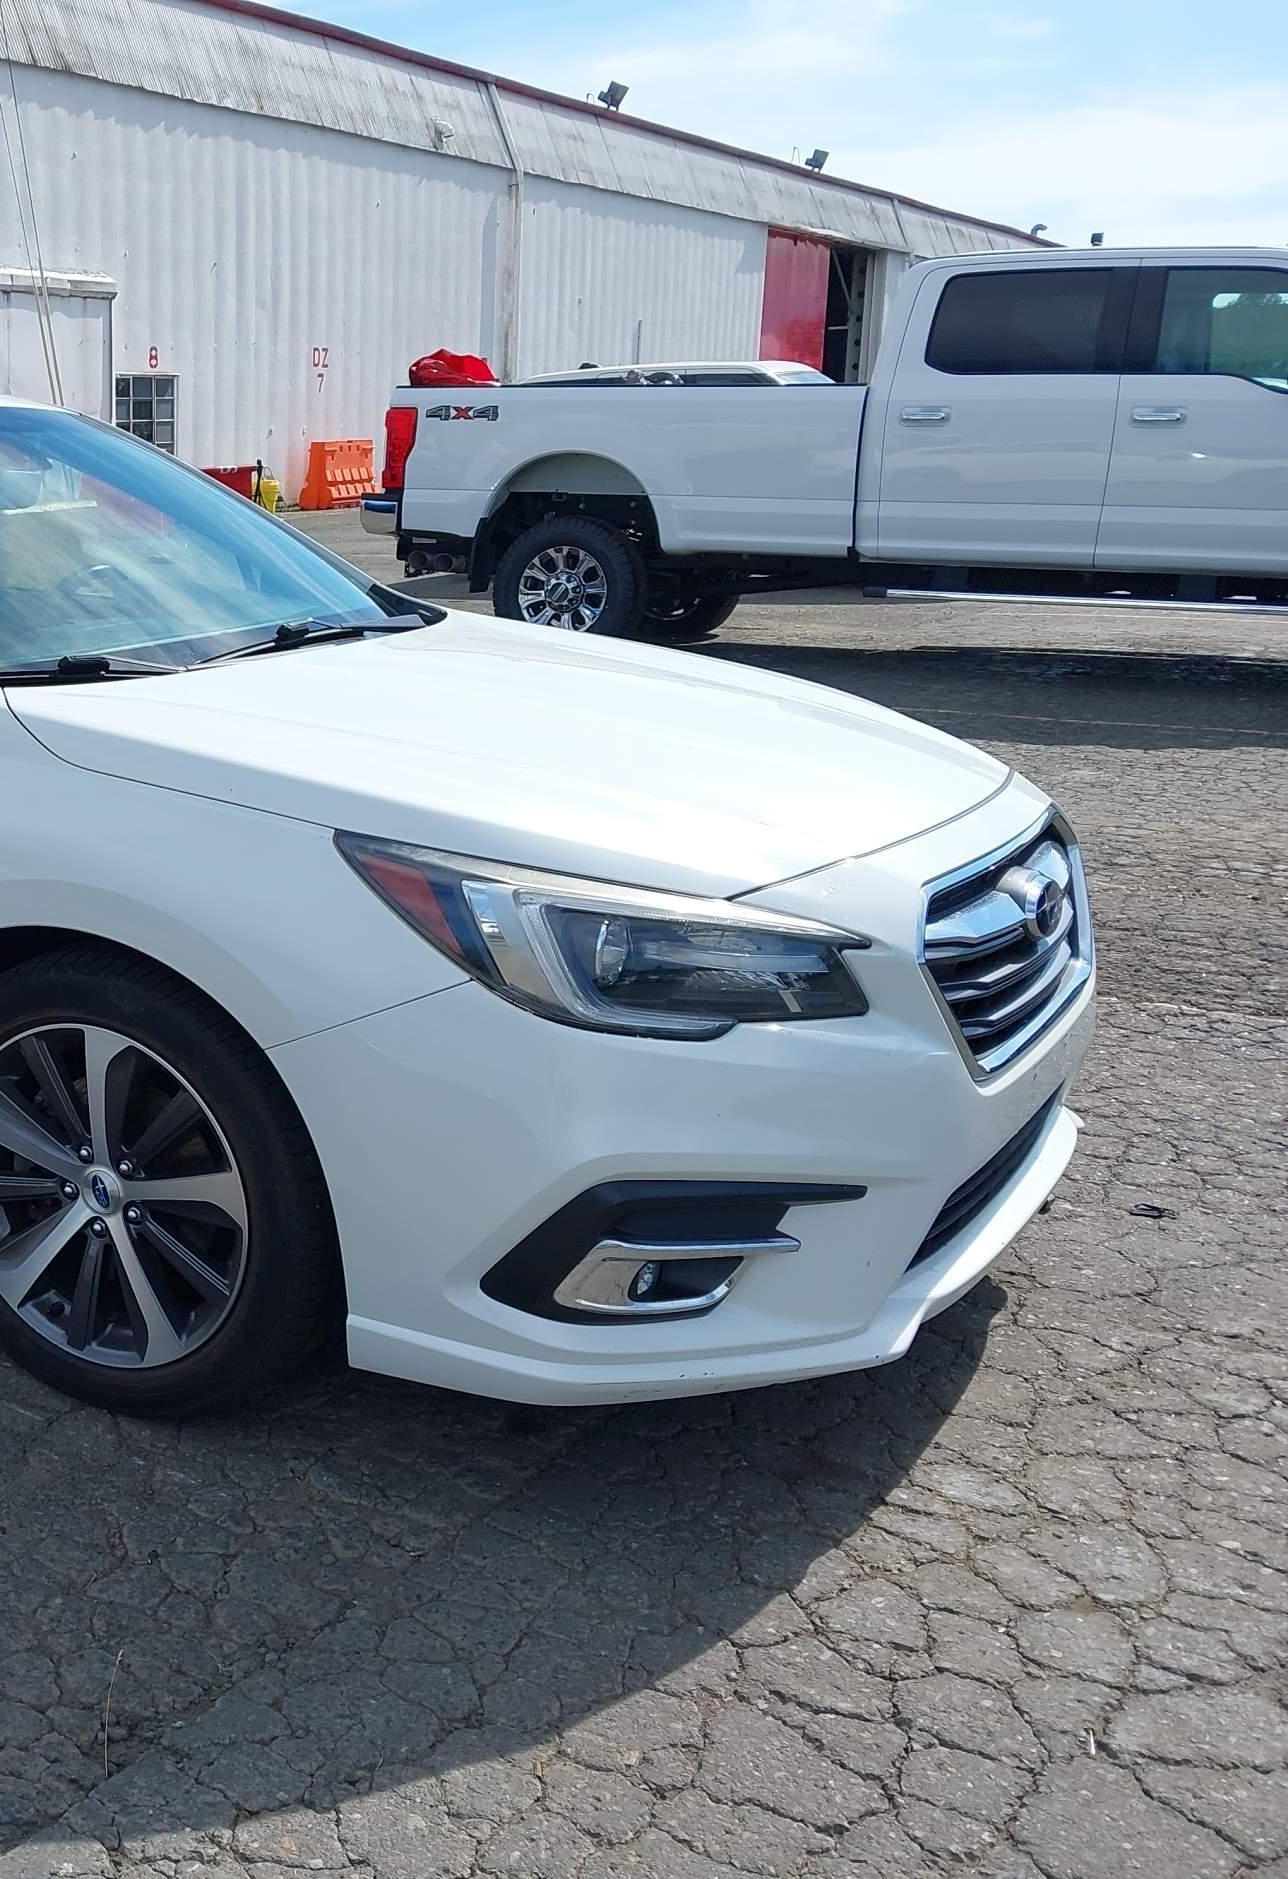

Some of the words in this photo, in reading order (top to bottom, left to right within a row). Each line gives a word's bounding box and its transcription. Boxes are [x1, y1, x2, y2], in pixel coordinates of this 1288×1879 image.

[148, 346, 159, 368] 8
[312, 347, 329, 368] DZ
[316, 373, 325, 393] 7
